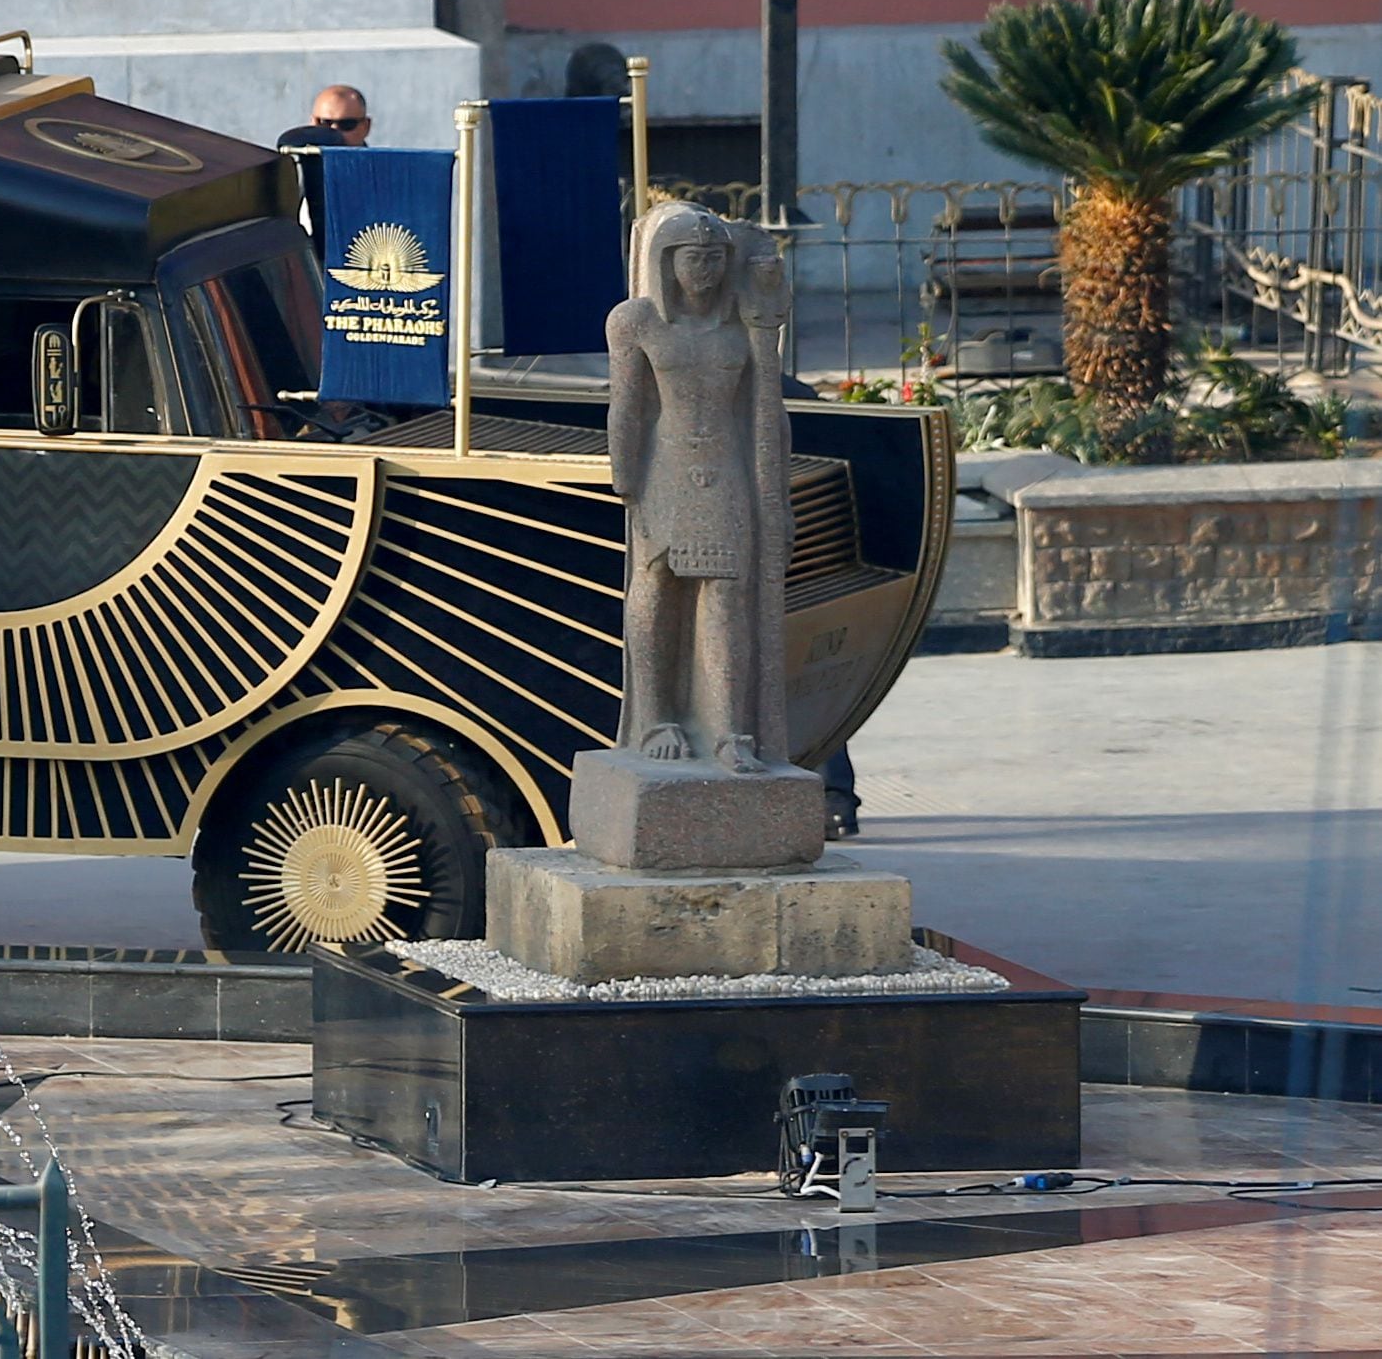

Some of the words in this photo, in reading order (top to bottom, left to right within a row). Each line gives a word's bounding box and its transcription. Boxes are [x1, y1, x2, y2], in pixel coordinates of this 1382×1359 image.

[324, 315, 360, 330] THE
[345, 332, 387, 342] GOLDEN
[386, 334, 426, 346] PARADE
